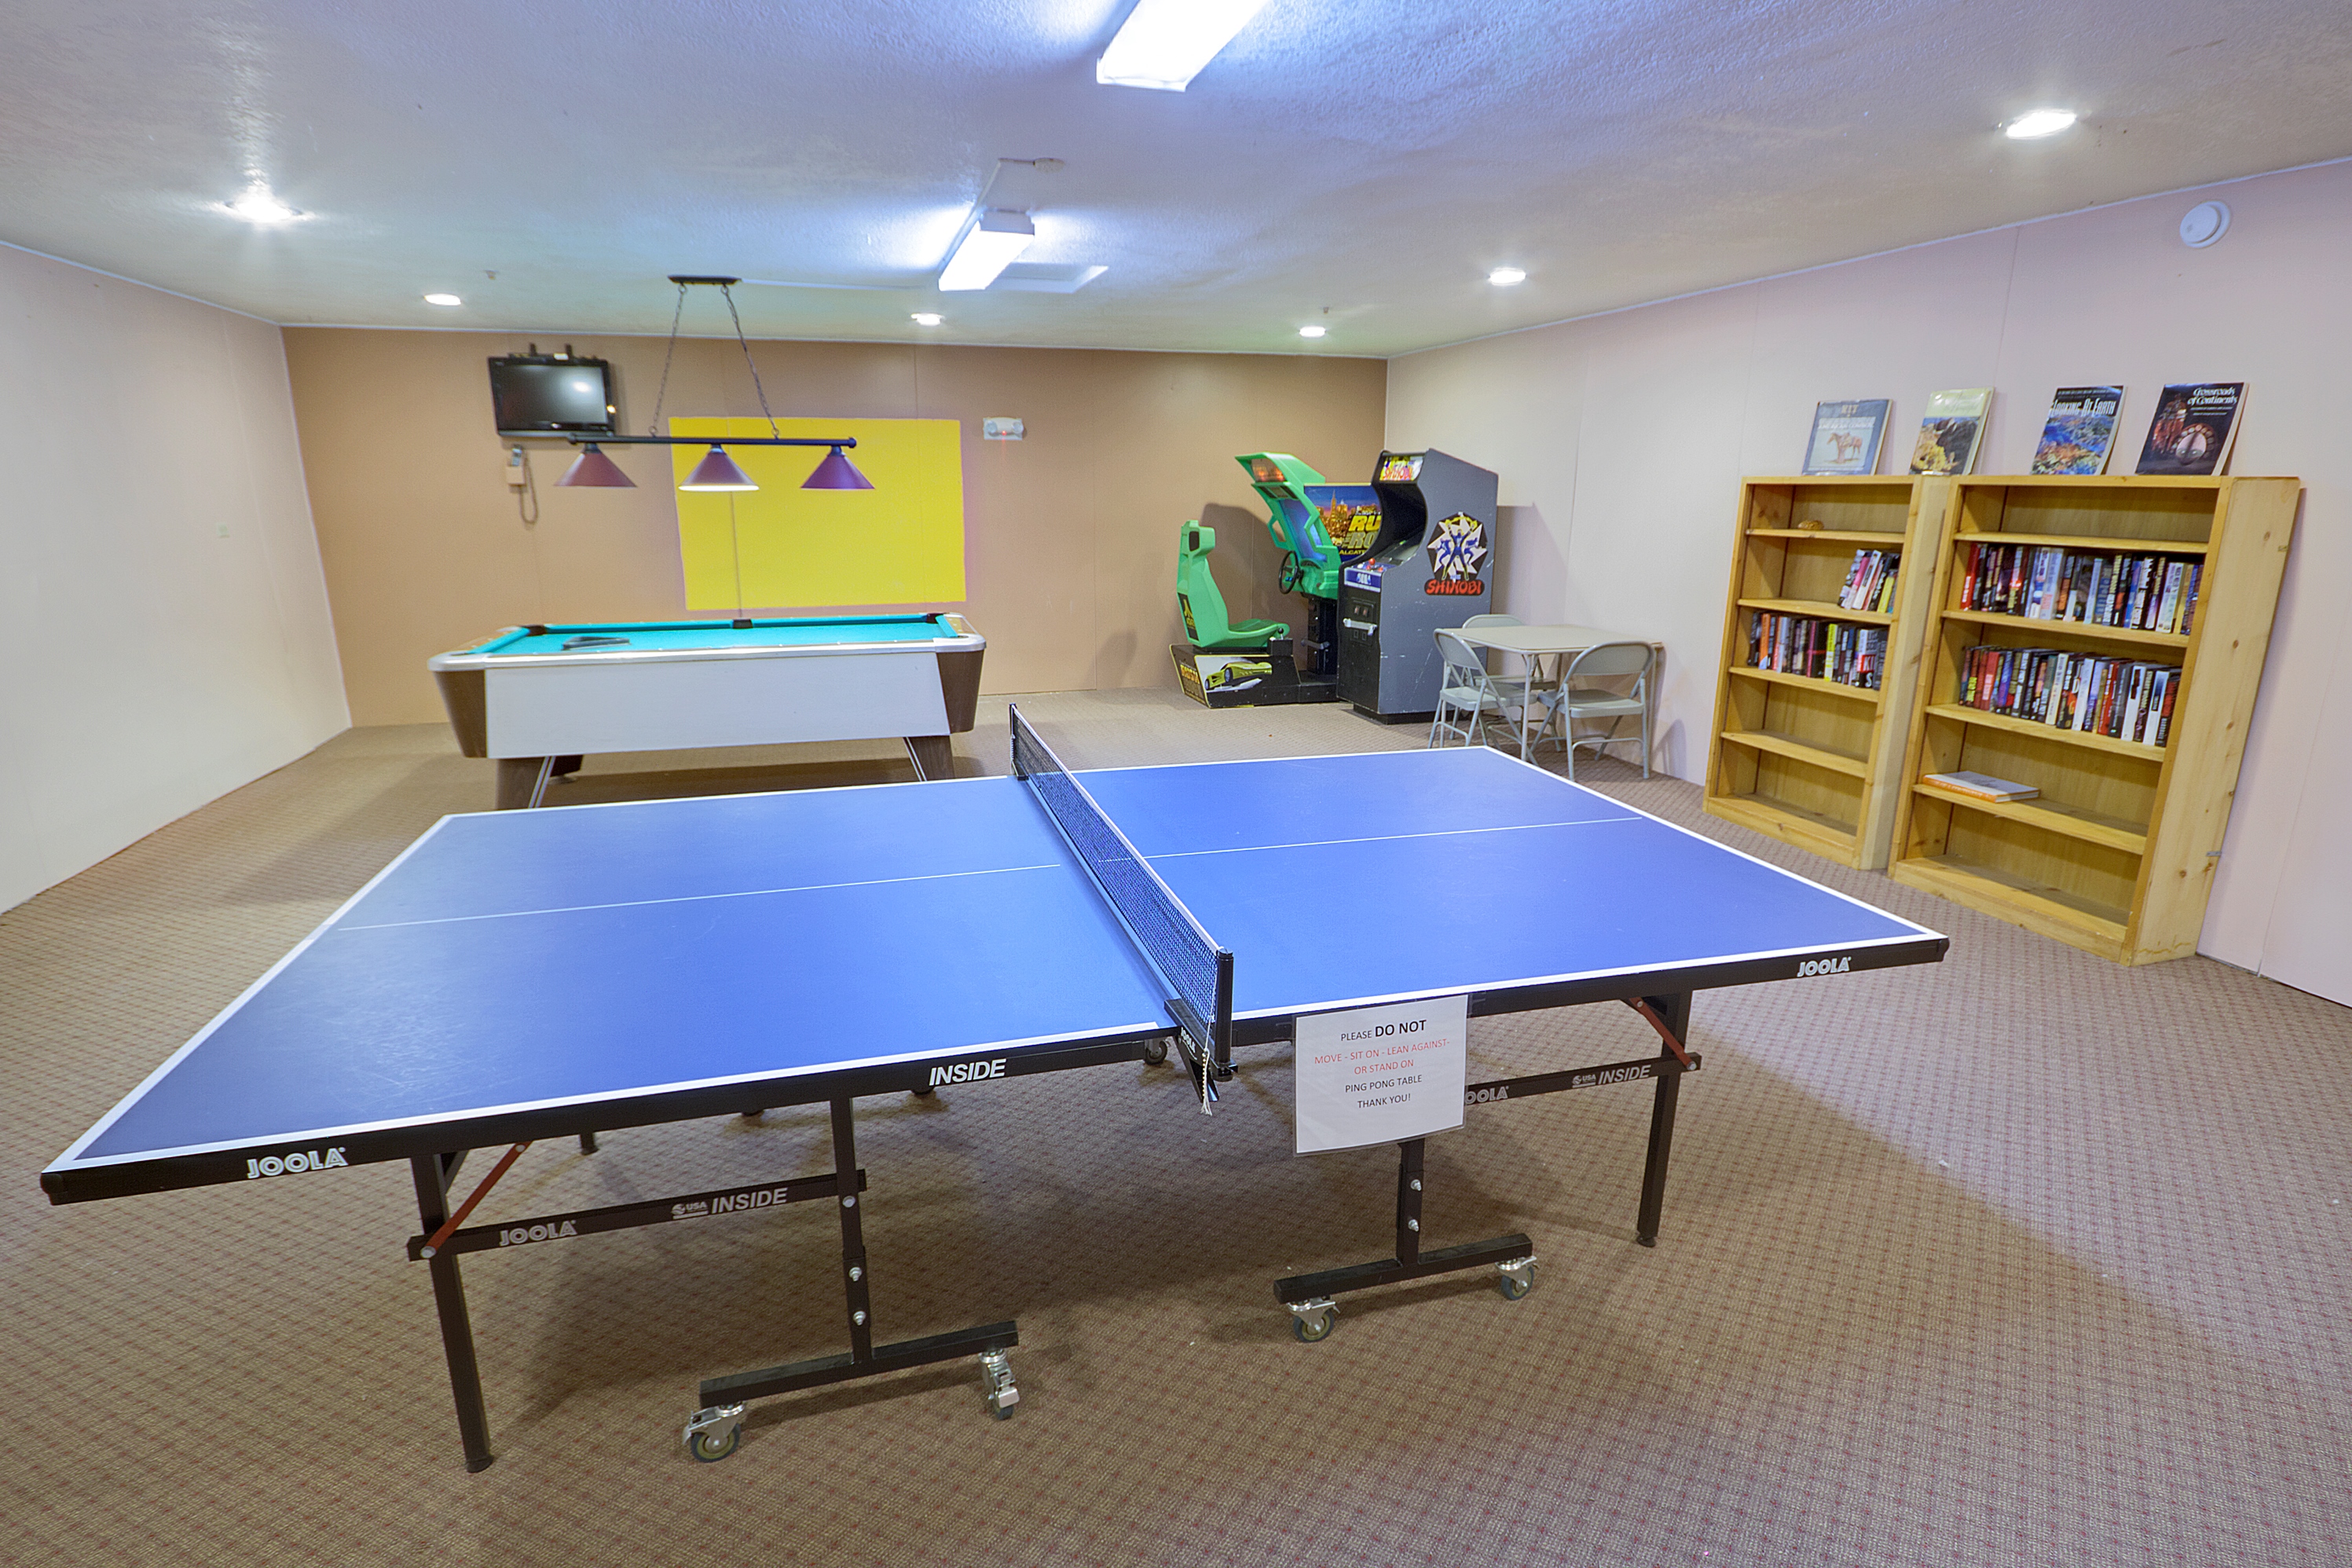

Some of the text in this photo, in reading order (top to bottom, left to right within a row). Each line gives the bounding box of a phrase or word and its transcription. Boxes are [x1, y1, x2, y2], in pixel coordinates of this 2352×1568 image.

[1348, 515, 1382, 532] RU
[1347, 532, 1378, 549] RO
[1426, 579, 1482, 595] SHINOBI
[1797, 956, 1852, 977] JOOLA
[1341, 1020, 1427, 1041] PLEASE DO NOT
[1314, 1053, 1342, 1064] MOVE
[1350, 1051, 1363, 1061] SIT
[1365, 1049, 1379, 1058] ON
[1387, 1046, 1409, 1056] LEAN
[929, 1058, 1006, 1086] INSIDE
[1354, 1060, 1414, 1075] OR STAND ON
[1582, 1064, 1651, 1085] USA INSIDE
[1345, 1075, 1422, 1093] PING PONG TABLE
[1357, 1093, 1411, 1108] THANK YOU!
[1464, 1086, 1509, 1105] OOLA
[247, 1147, 349, 1178] JOOLA
[686, 1187, 788, 1214] USA INSIDE
[499, 1220, 577, 1247] JOOLA
